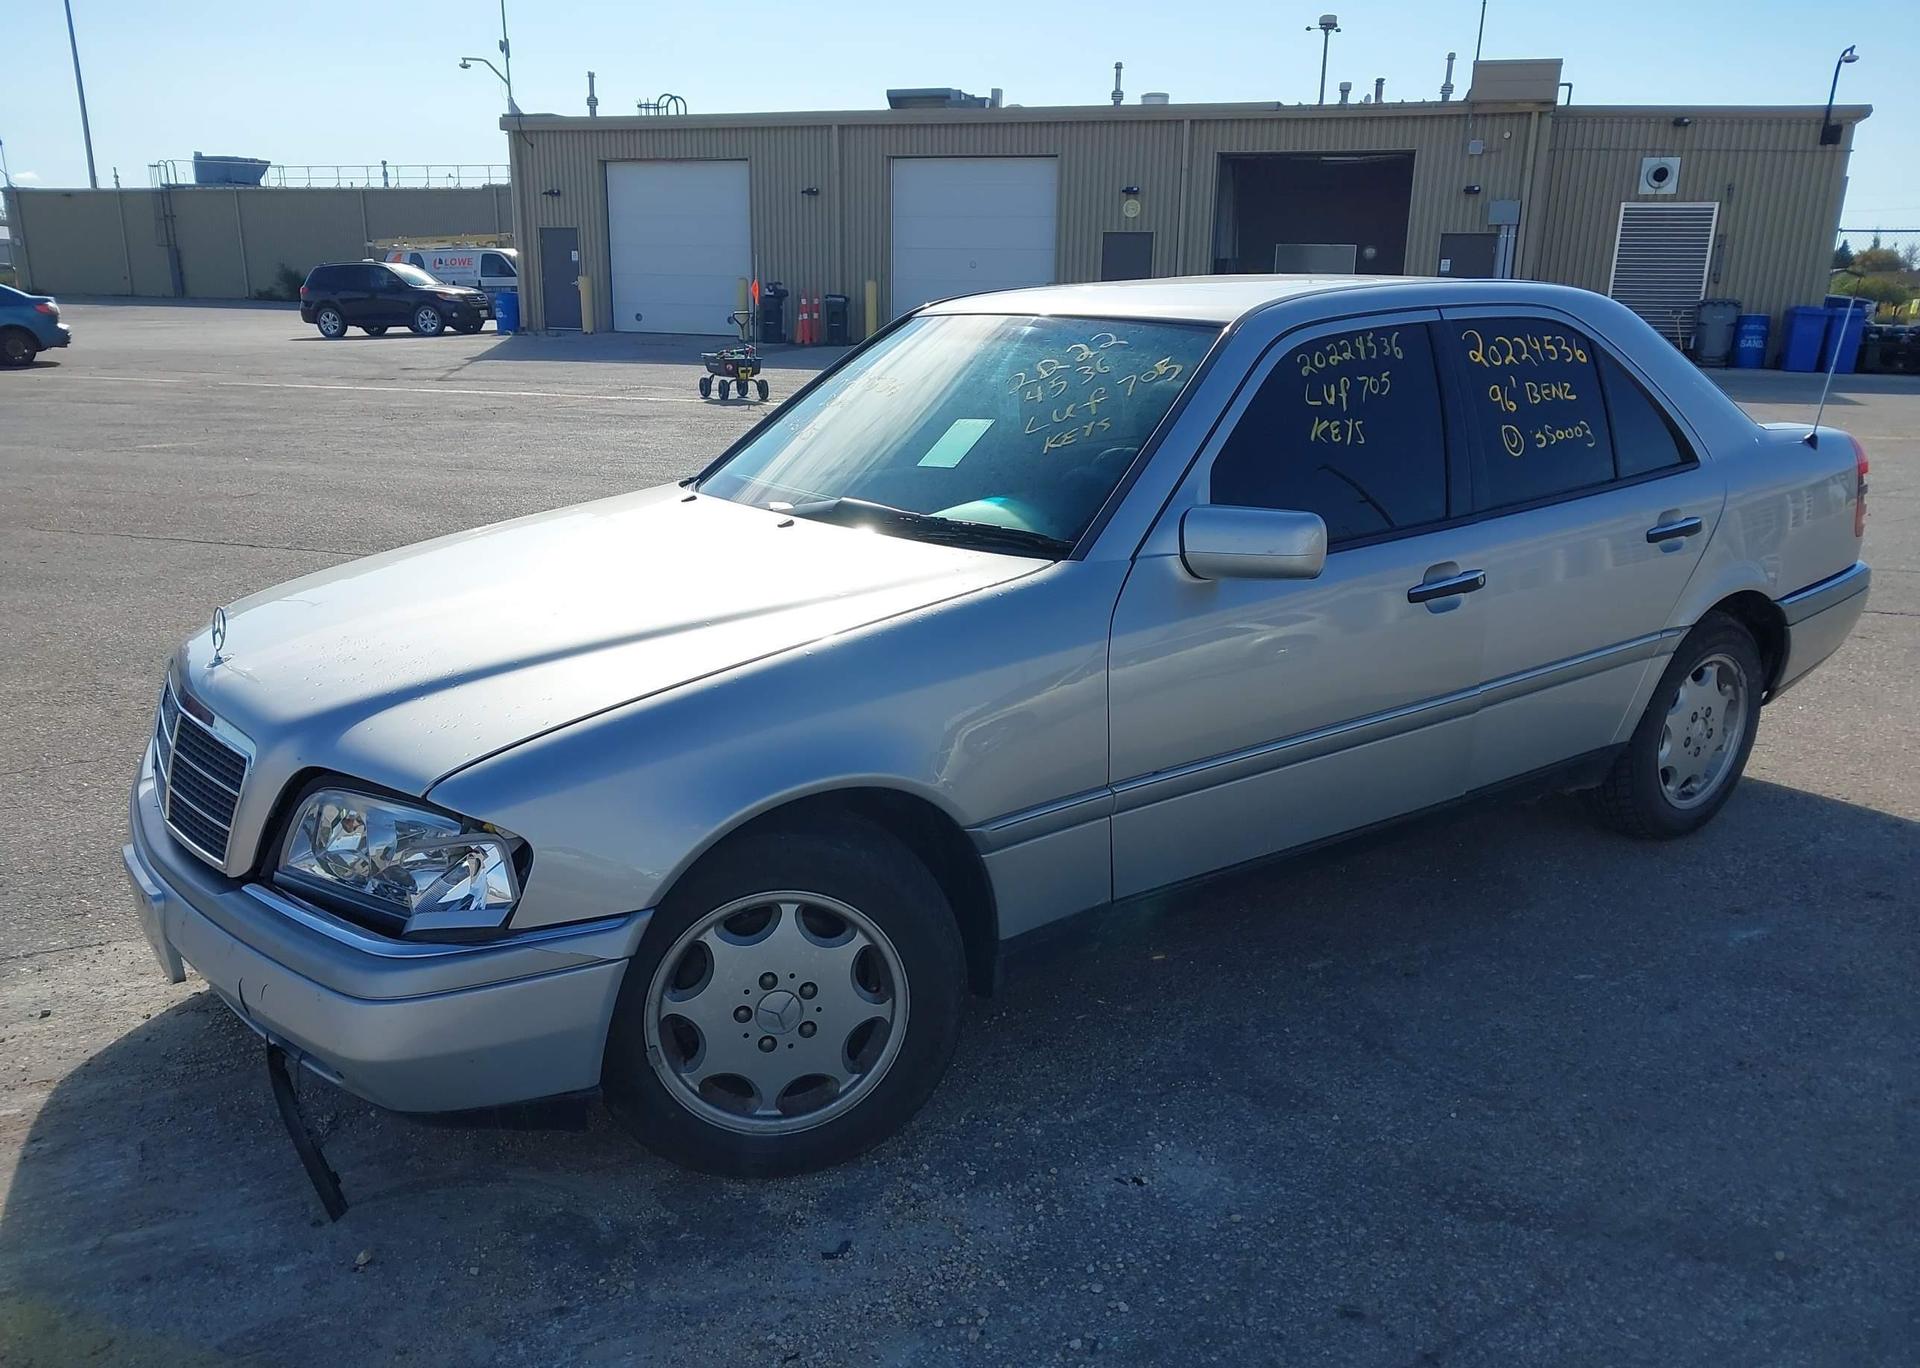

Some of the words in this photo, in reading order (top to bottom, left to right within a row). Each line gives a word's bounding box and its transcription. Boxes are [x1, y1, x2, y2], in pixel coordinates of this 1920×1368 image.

[444, 257, 473, 267] LOWE
[1296, 331, 1404, 377] 20224536
[1461, 329, 1588, 368] 20224536
[1740, 339, 1764, 349] SAND
[1023, 357, 1111, 403] 4536
[1116, 356, 1183, 397] 705
[1356, 370, 1391, 403] 705
[1525, 381, 1577, 404] BENZ
[1042, 417, 1112, 455] KEYS
[1310, 416, 1365, 445] KEYS
